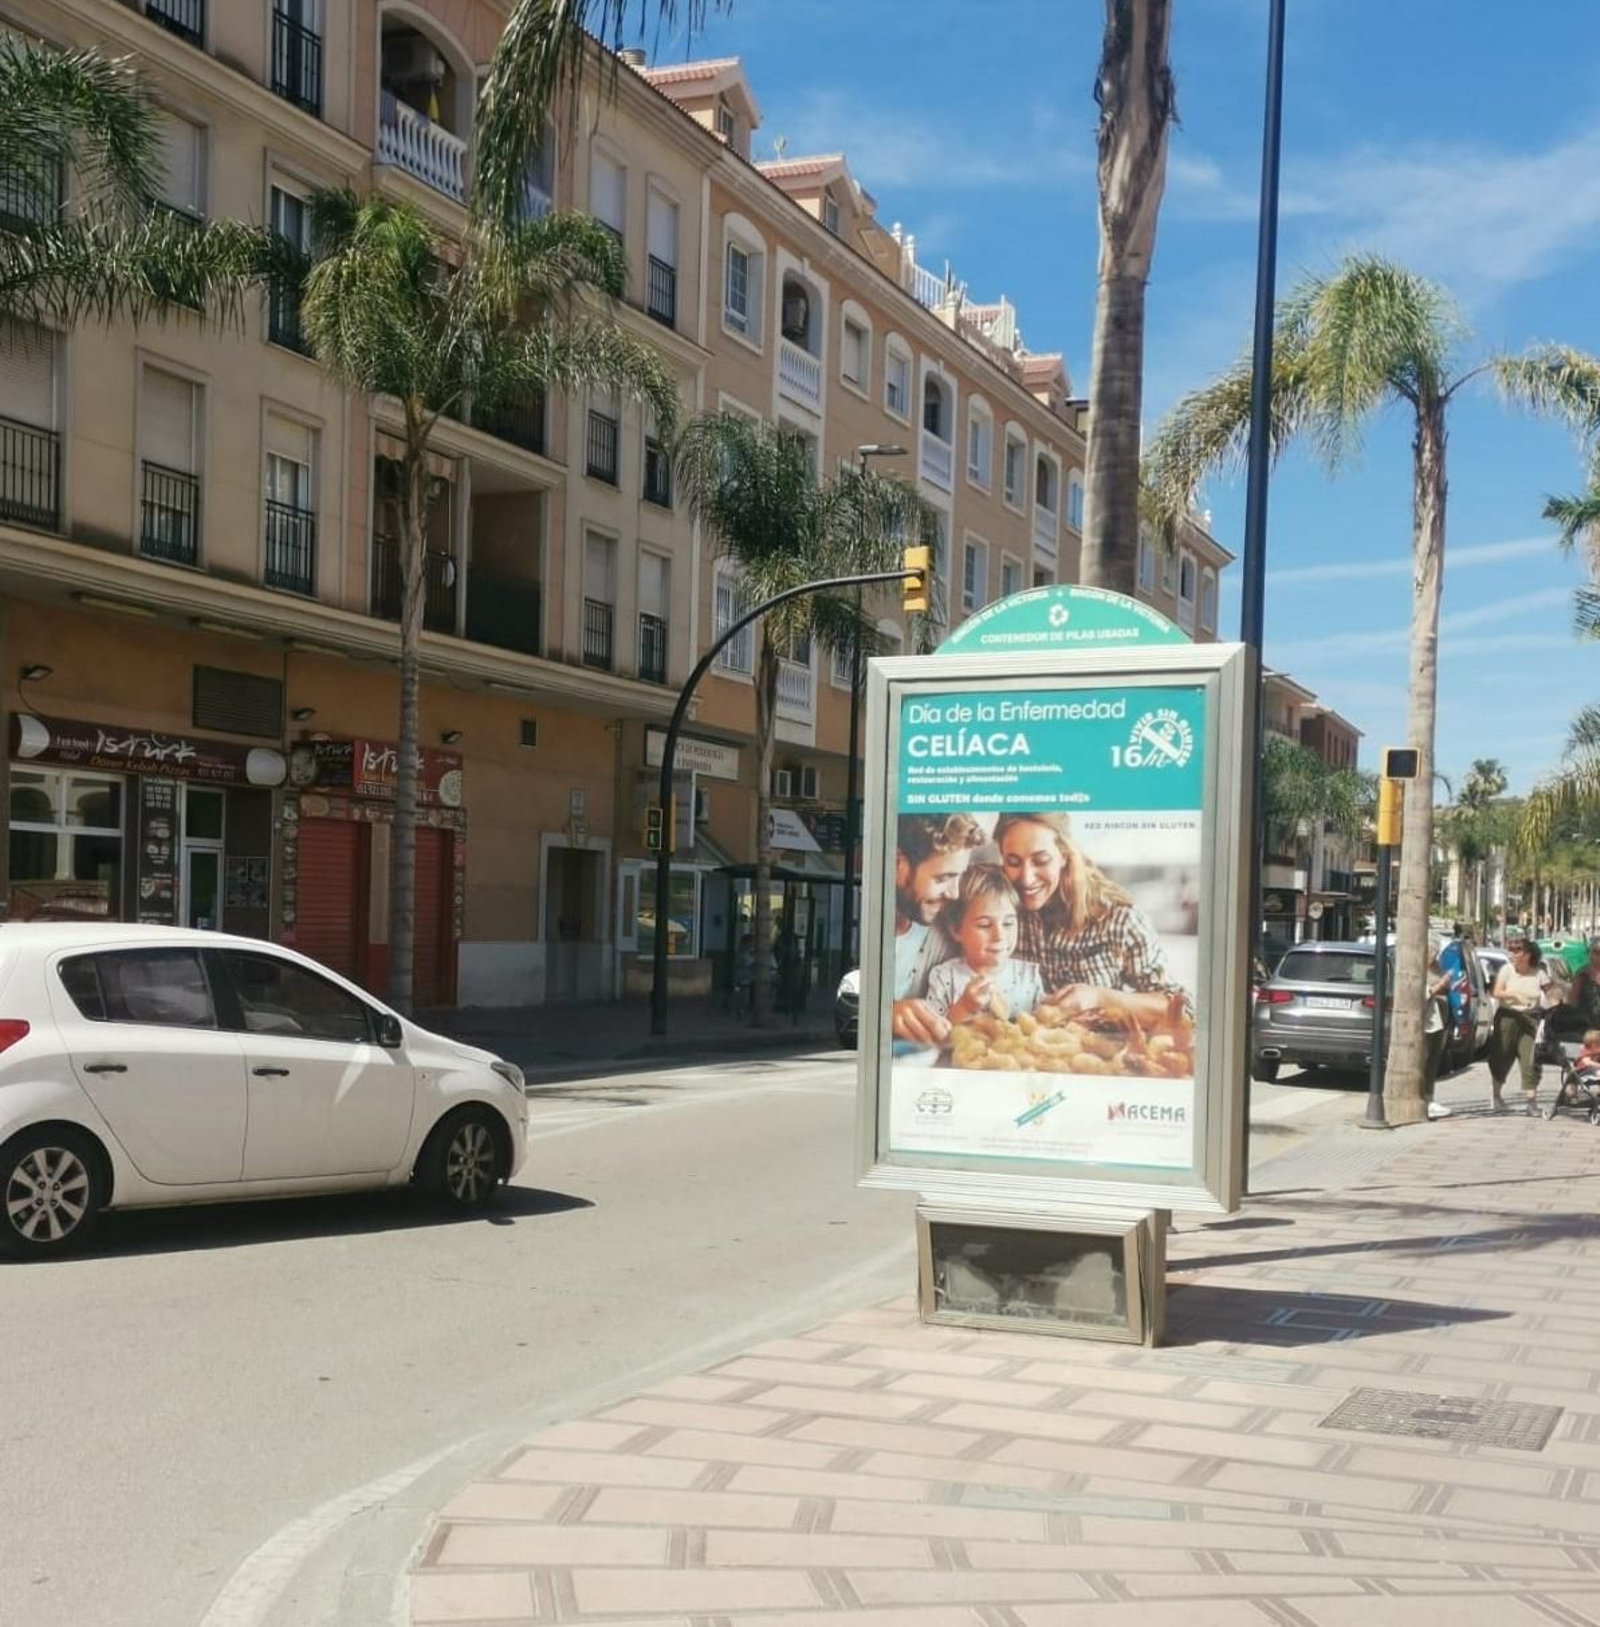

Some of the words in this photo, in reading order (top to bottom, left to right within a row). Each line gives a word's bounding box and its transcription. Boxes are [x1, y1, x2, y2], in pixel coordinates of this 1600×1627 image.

[994, 602, 1008, 614] LA
[1008, 590, 1050, 608] VICTORIA
[1106, 593, 1119, 605] DE
[1118, 597, 1133, 610] LA
[1133, 603, 1170, 634] VICTORIA
[980, 632, 1048, 645] CONTENEDOR
[1050, 631, 1064, 643] DE
[1066, 630, 1095, 642] PILAS
[1096, 628, 1140, 640] USADAS
[909, 703, 941, 724] Día
[946, 703, 973, 723] de
[977, 702, 995, 722] la
[1000, 698, 1126, 721] Enfermedad
[907, 727, 1031, 757] CELÍACA
[1129, 711, 1153, 743] VIVIR
[1157, 708, 1178, 720] SIN
[1177, 719, 1193, 768] GLUTEN
[1110, 745, 1143, 768] 16
[908, 766, 925, 775] Red
[926, 766, 936, 775] de
[937, 765, 1005, 775] establecimientos
[1006, 765, 1018, 774] de
[907, 794, 926, 804] SIN
[928, 794, 970, 804] GLUTEN
[972, 793, 1004, 804] donde
[1006, 793, 1057, 804] comemos
[1084, 822, 1102, 830] RED
[1141, 822, 1157, 830] SIN
[1159, 822, 1196, 830] GLUTEN
